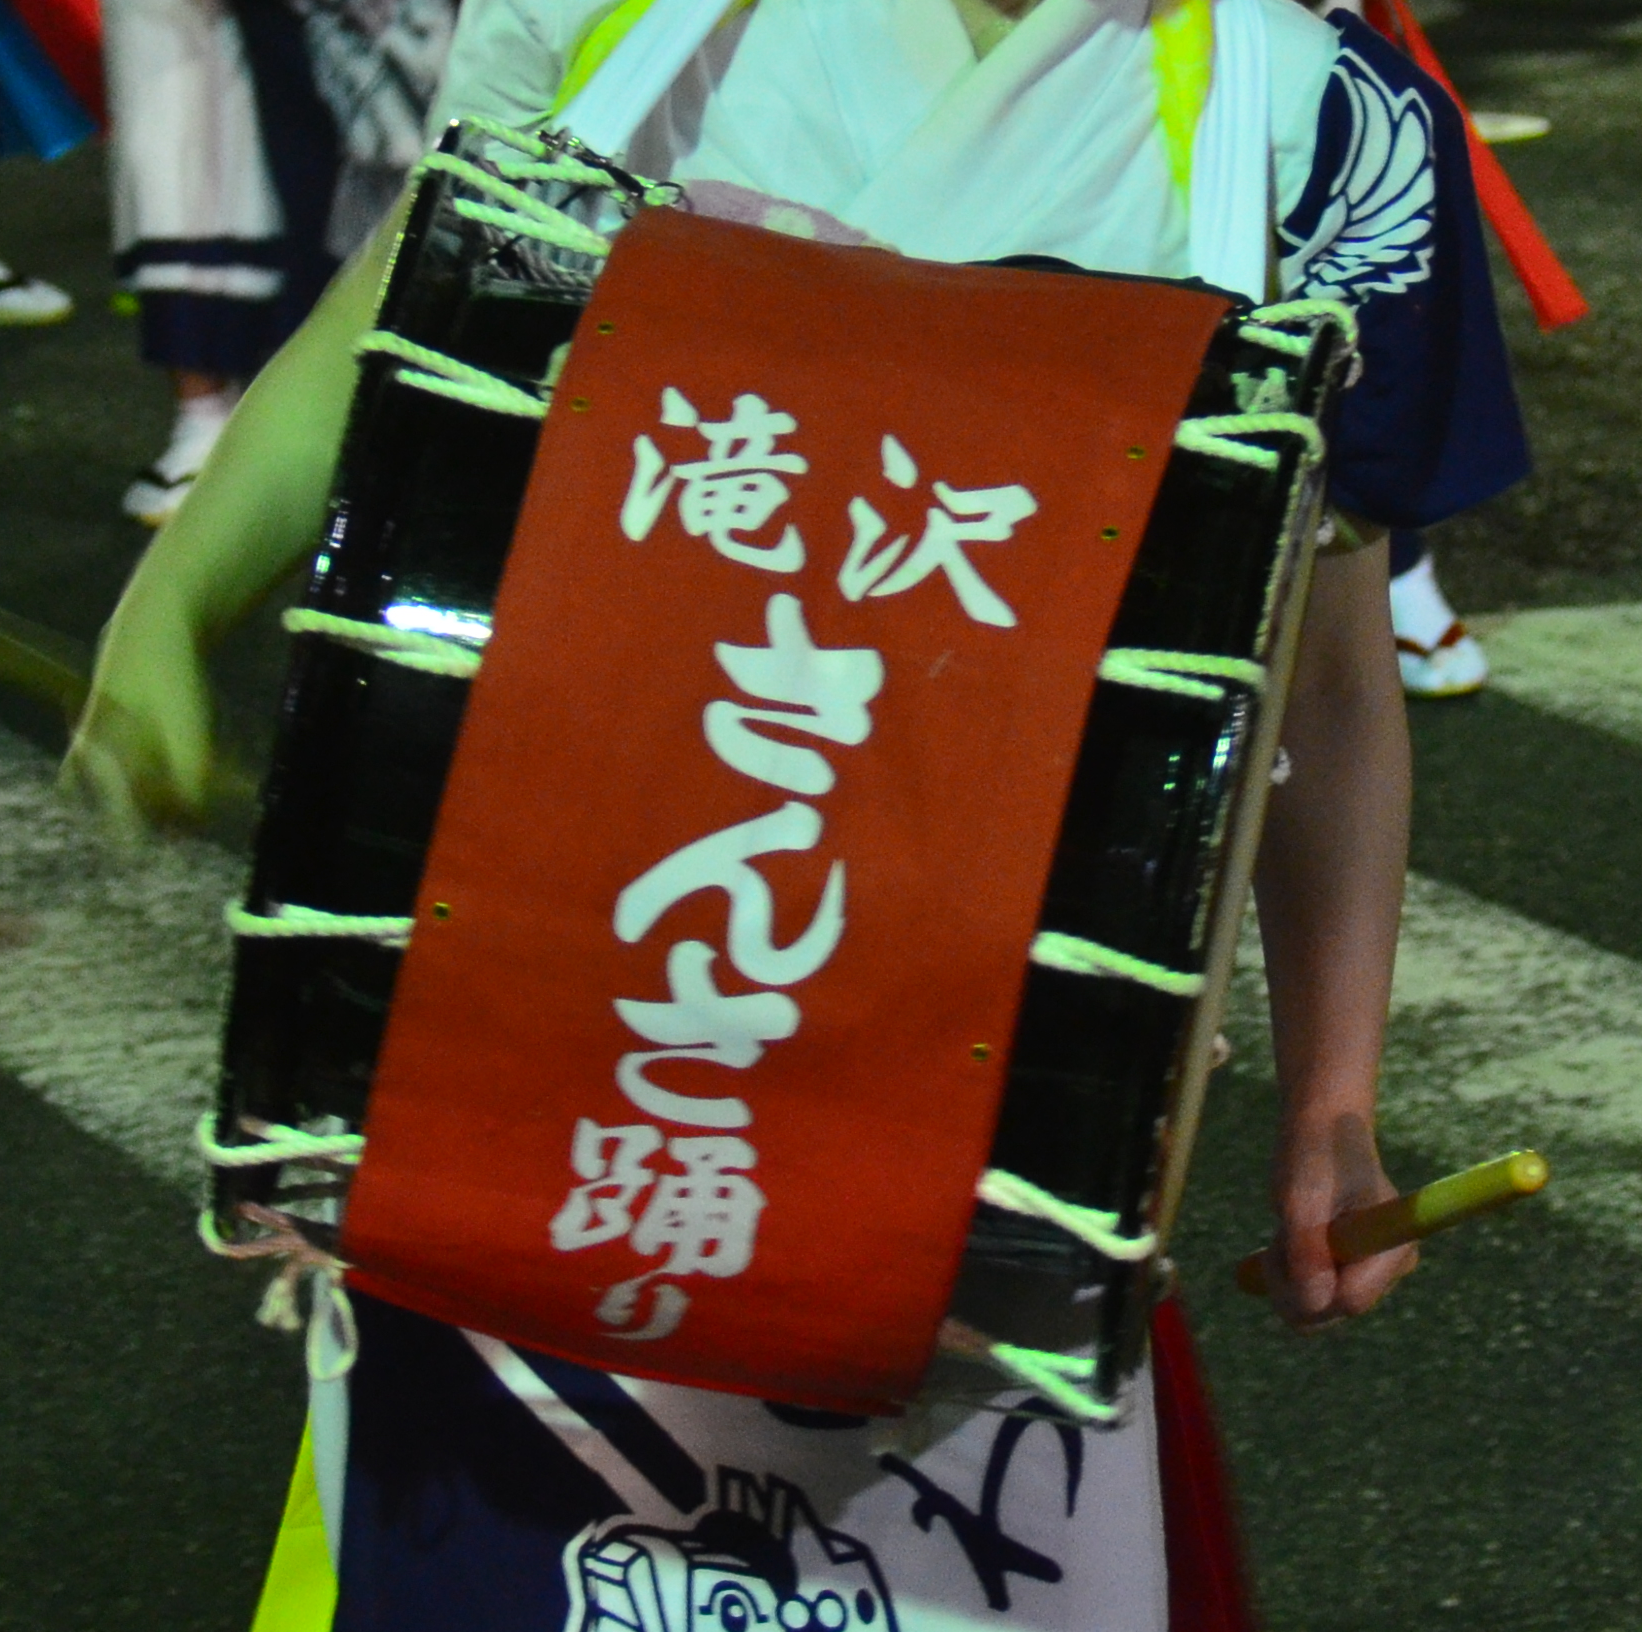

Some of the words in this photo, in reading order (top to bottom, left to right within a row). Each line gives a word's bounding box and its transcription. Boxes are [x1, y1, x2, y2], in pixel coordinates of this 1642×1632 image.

[620, 386, 1037, 629] 滝沢
[552, 592, 885, 1343] さんさ踊り
